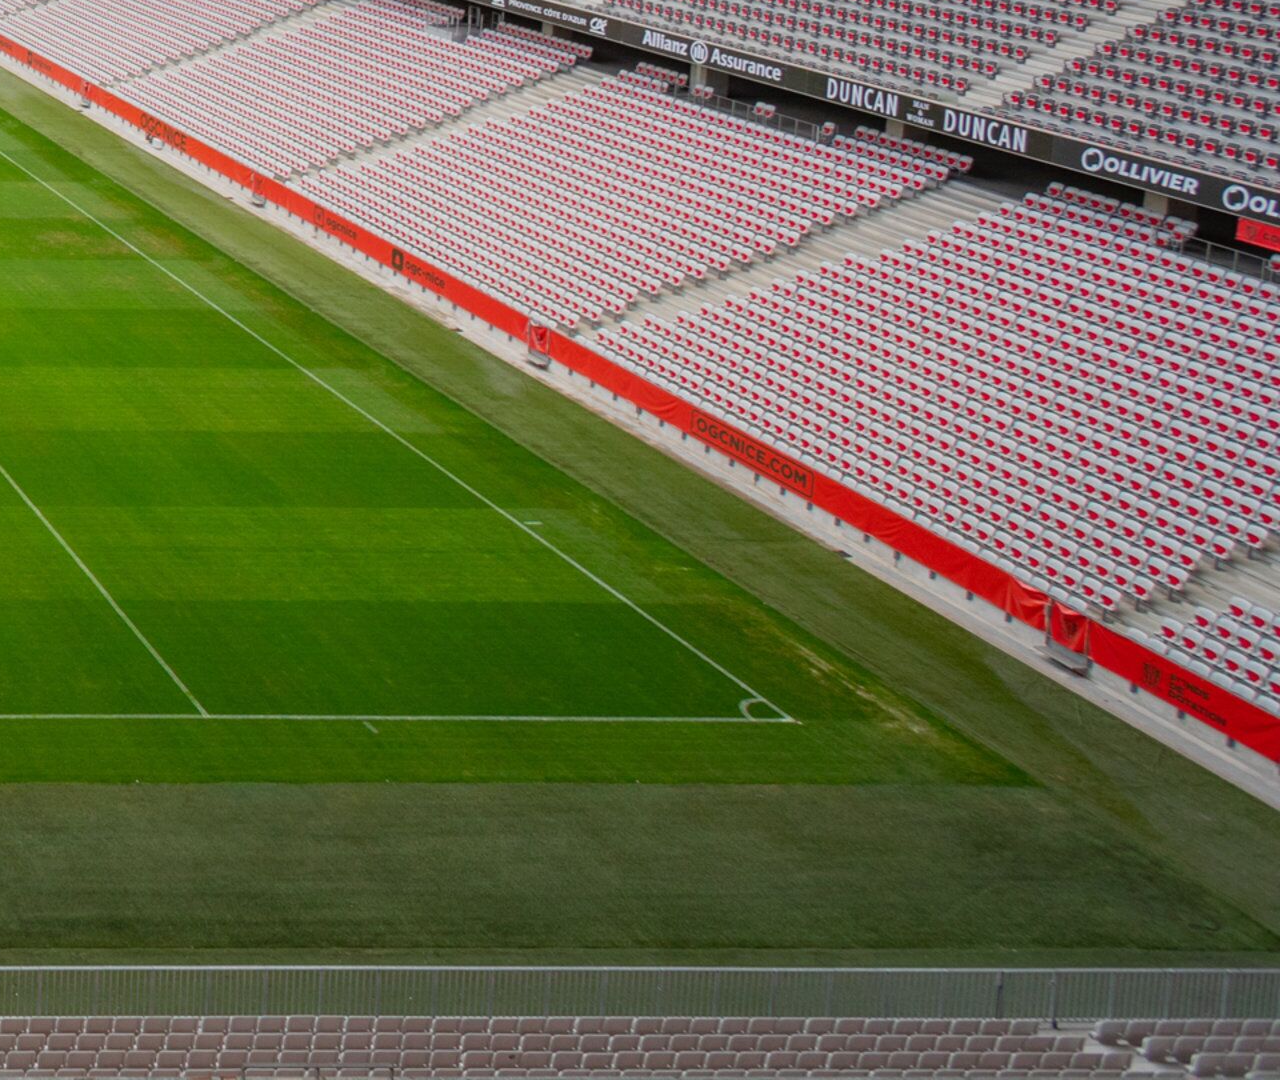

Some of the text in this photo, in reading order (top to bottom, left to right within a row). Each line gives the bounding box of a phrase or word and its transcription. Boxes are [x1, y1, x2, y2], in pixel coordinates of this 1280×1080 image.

[642, 29, 783, 81] Allianz Assurance
[826, 77, 899, 118] DUNCAN
[943, 108, 1029, 153] DUNCAN
[696, 417, 808, 489] OGCNICE.COM
